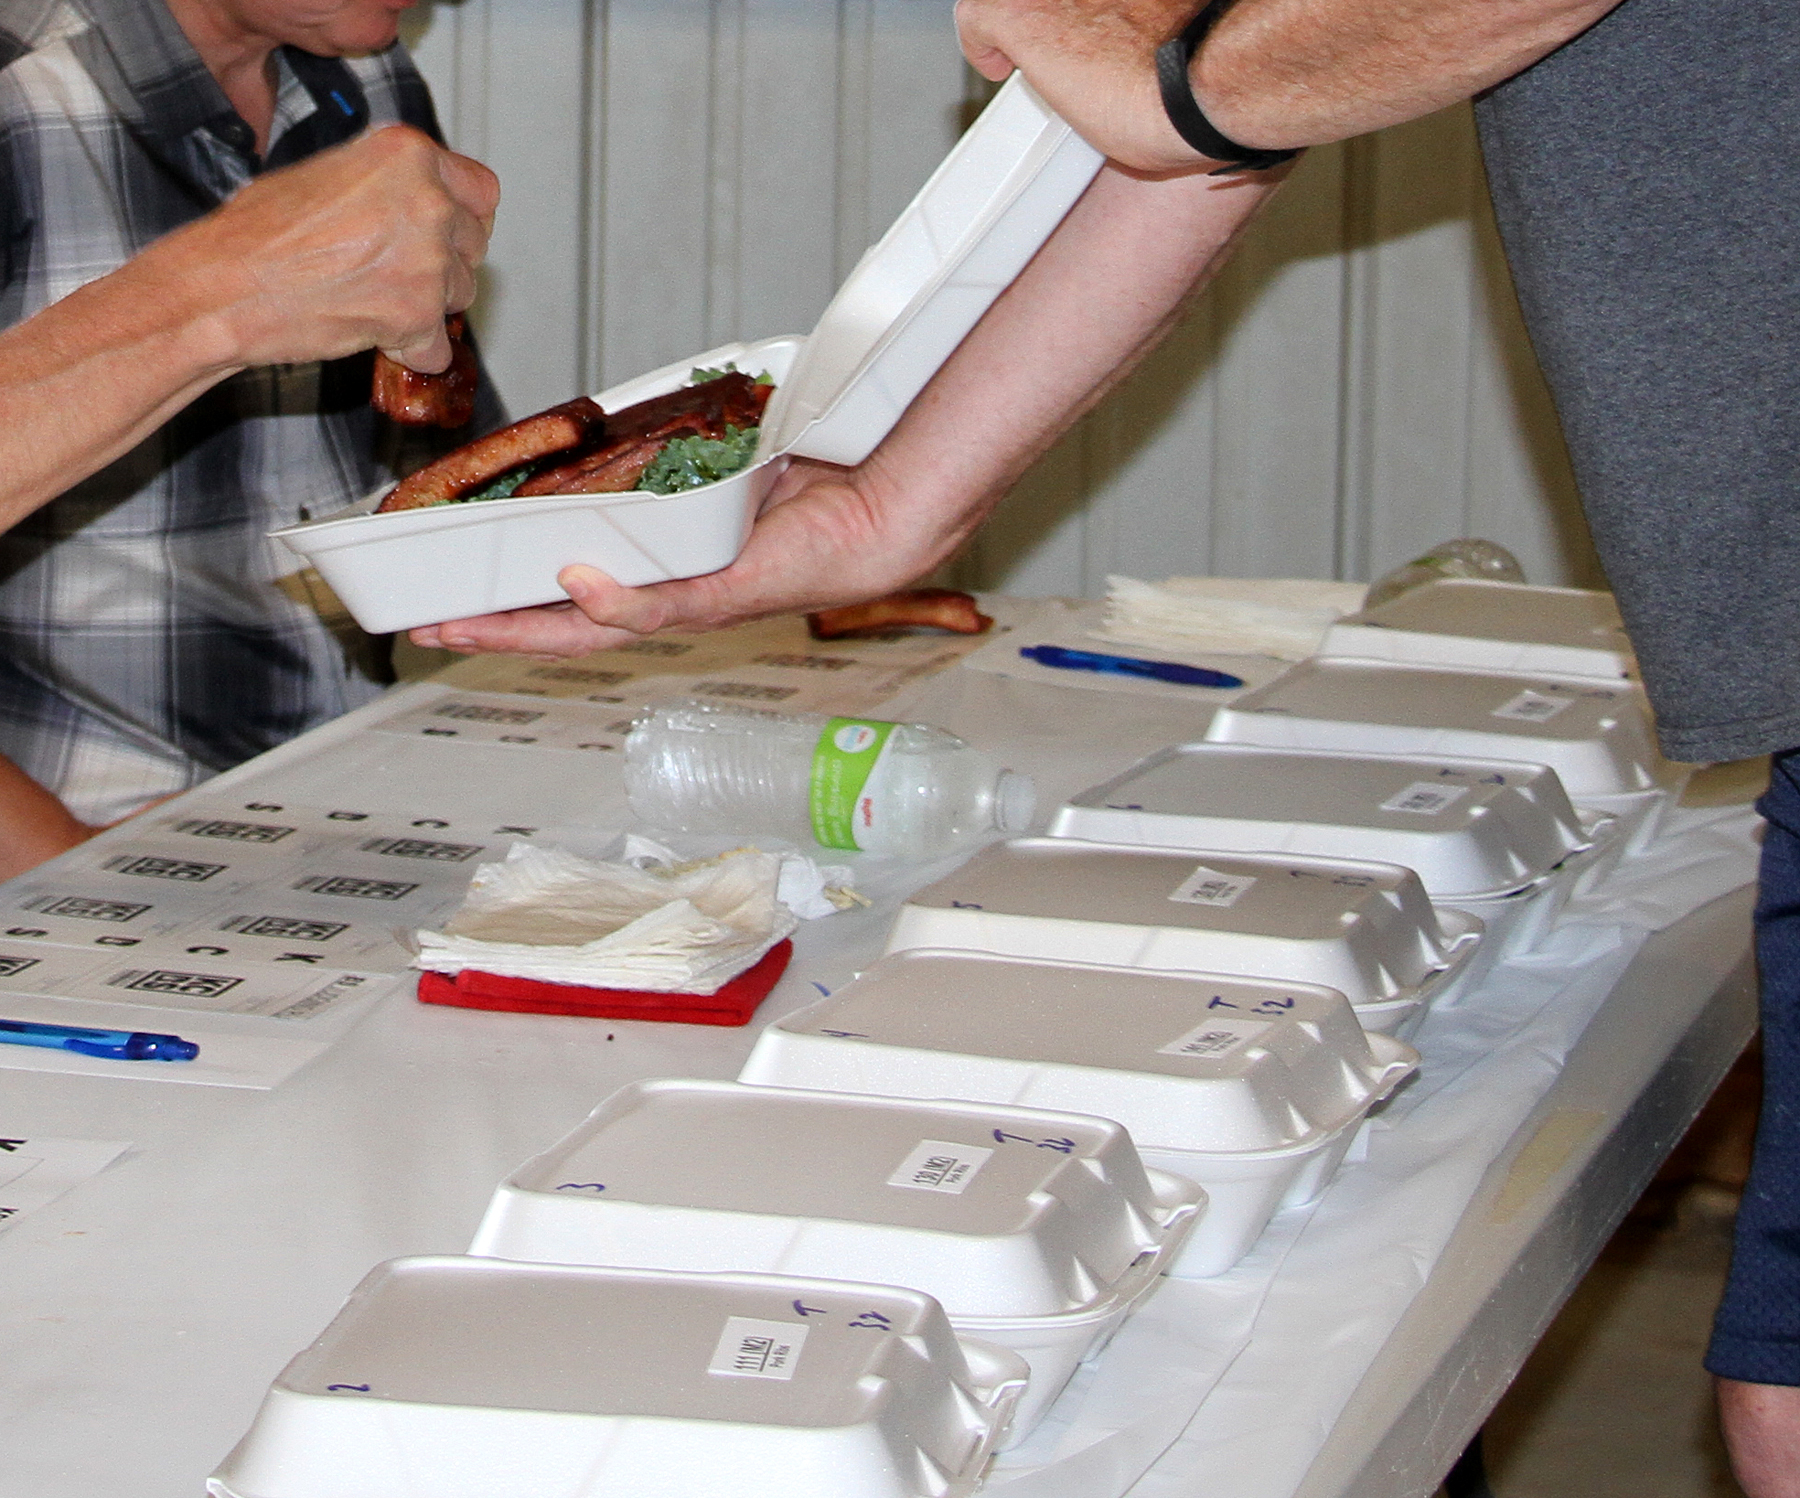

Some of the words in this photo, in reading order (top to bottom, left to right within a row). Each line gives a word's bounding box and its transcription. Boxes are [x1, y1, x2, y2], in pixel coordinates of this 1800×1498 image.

[186, 945, 229, 956] C
[274, 952, 325, 964] K
[1207, 996, 1239, 1009] T
[993, 1129, 1034, 1143] T
[792, 1299, 827, 1316] T
[740, 1336, 775, 1355] (M2)
[734, 1354, 761, 1370] 111
